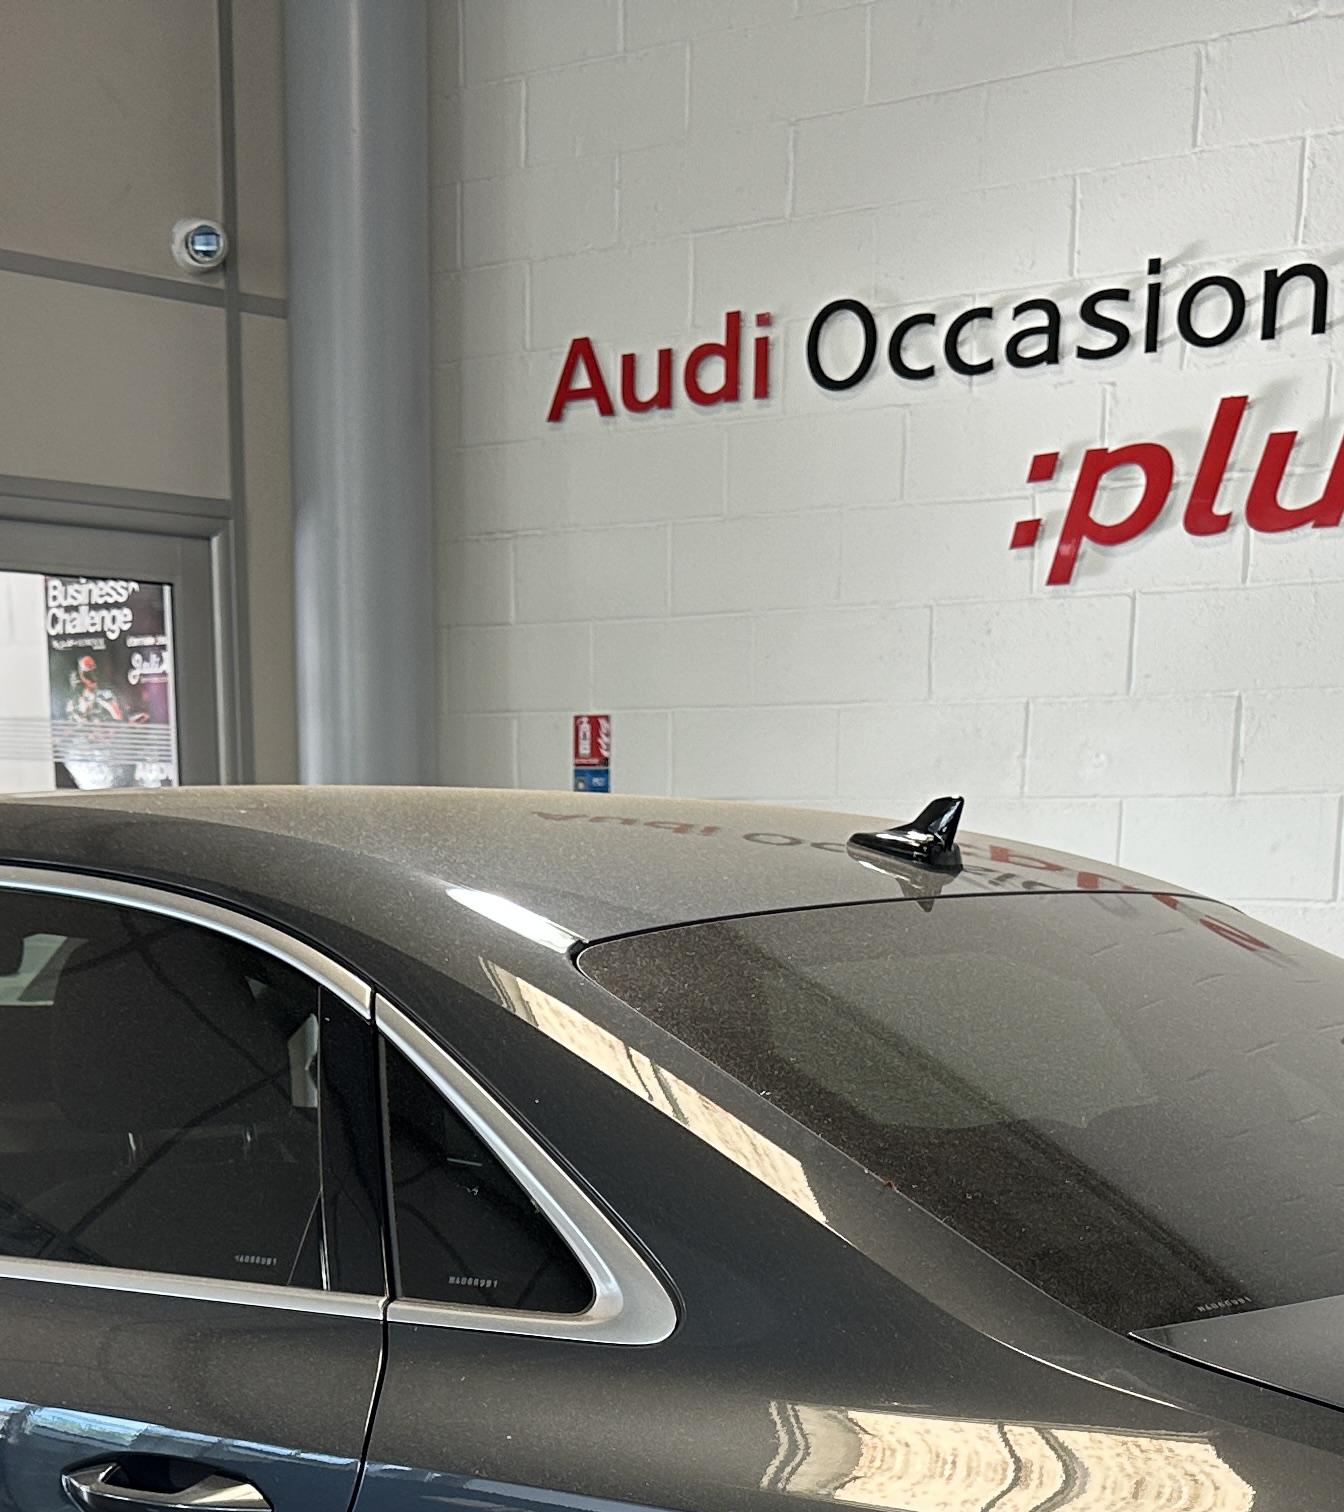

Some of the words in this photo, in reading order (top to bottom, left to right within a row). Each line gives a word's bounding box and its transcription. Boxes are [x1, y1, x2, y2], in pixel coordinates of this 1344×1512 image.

[548, 310, 771, 422] Audi
[805, 257, 1330, 393] Occasion
[47, 576, 129, 608] Business
[46, 606, 134, 641] Challenge
